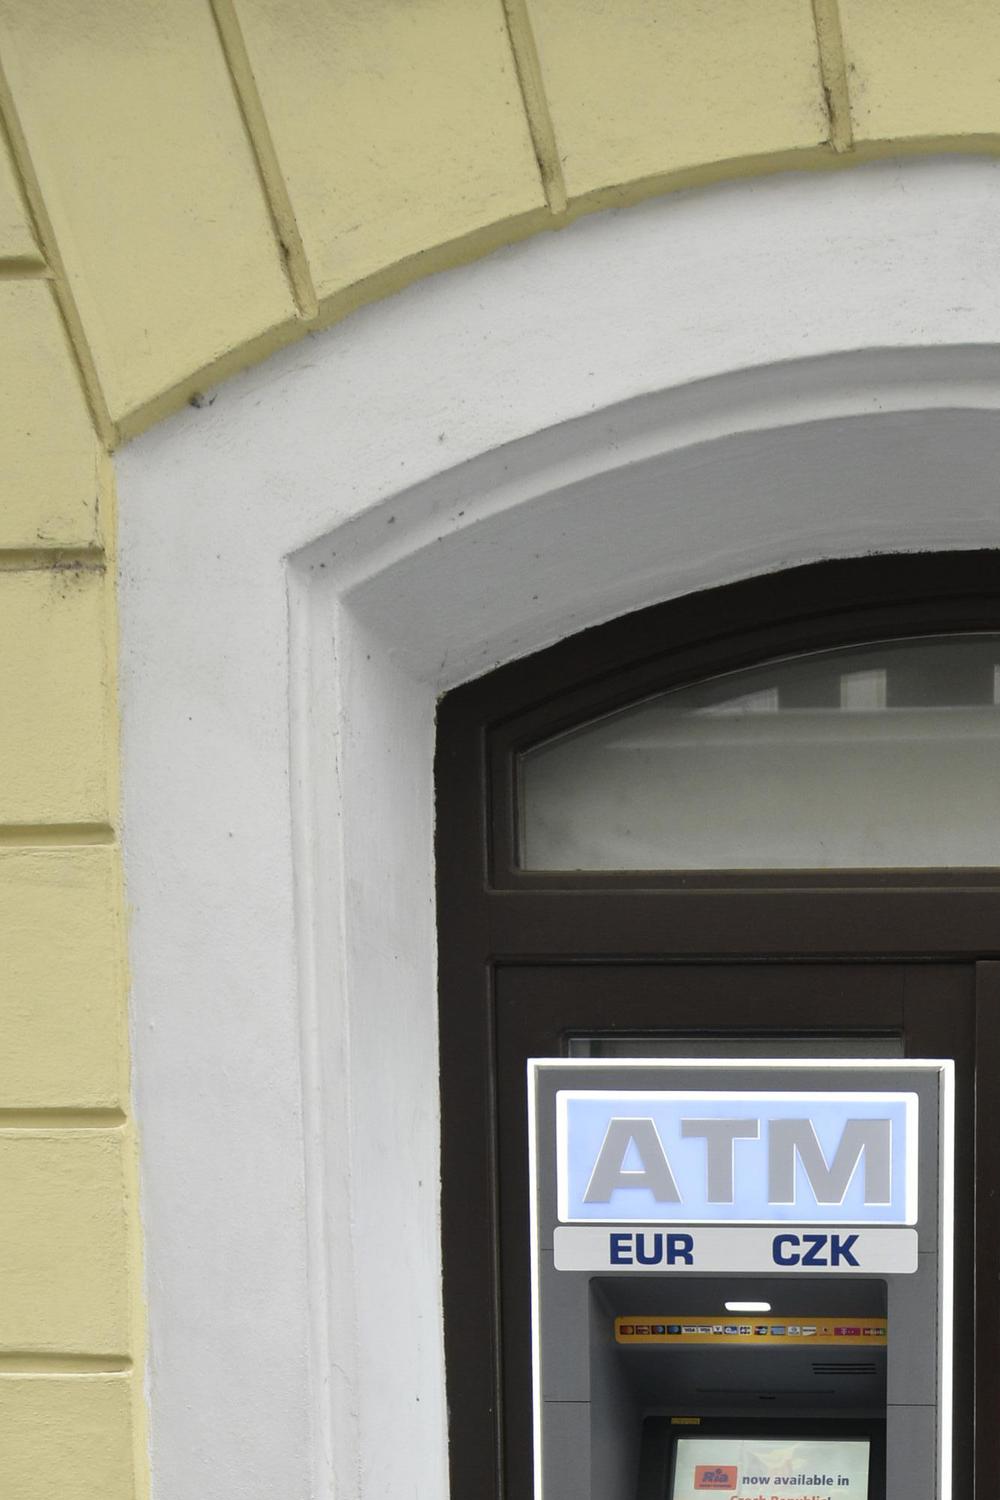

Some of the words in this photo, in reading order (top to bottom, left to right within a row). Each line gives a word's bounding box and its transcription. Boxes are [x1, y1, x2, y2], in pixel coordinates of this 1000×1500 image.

[582, 1116, 893, 1206] ATM
[609, 1233, 694, 1266] EUR
[771, 1234, 861, 1268] CZK
[702, 1468, 729, 1482] Ria
[742, 1475, 770, 1485] now
[774, 1474, 834, 1486] available
[838, 1475, 850, 1486] in
